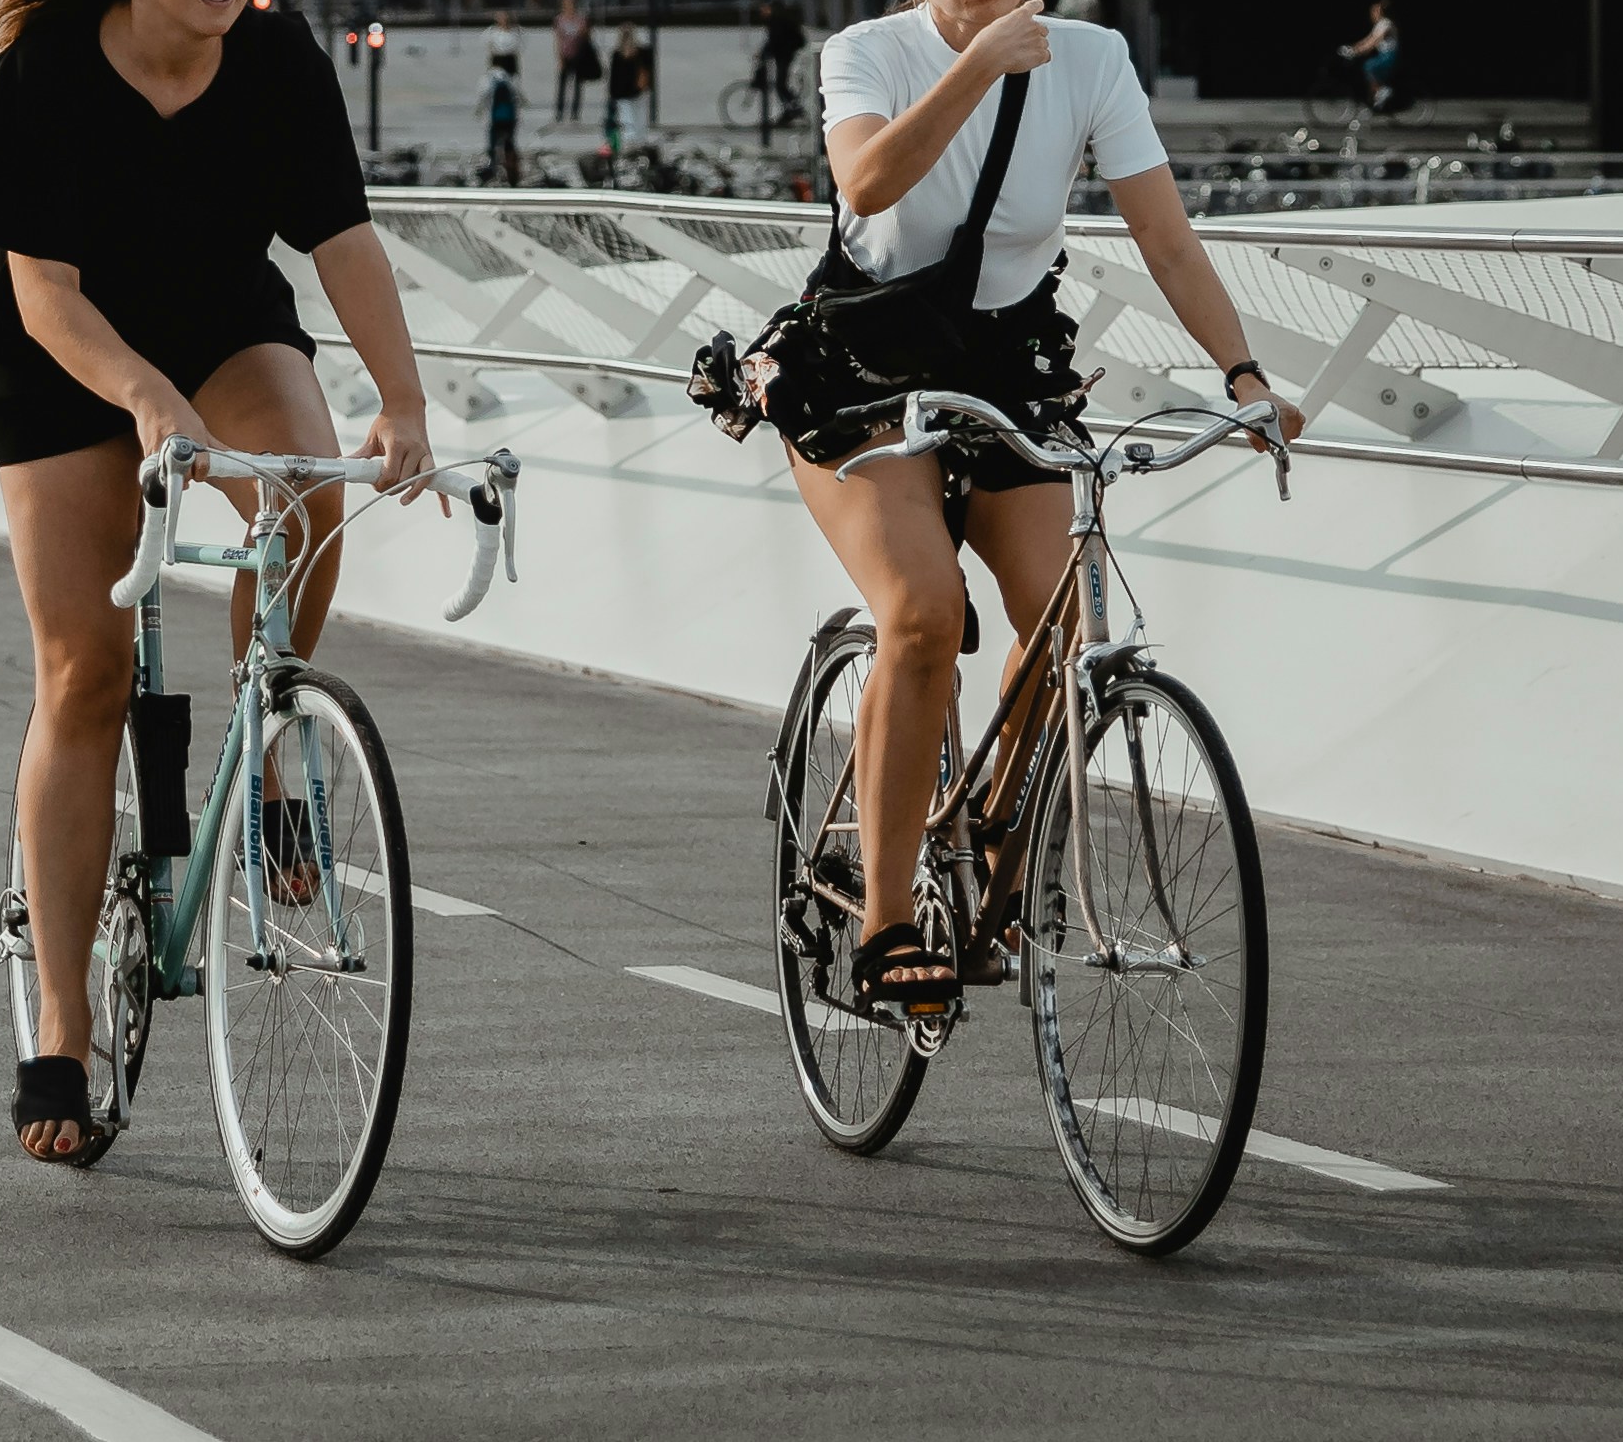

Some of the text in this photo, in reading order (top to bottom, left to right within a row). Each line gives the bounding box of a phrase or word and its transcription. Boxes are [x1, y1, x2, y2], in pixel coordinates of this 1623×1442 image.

[1091, 567, 1103, 613] ALIMO
[250, 774, 263, 868] Bianchi
[311, 778, 332, 871] Bianchi
